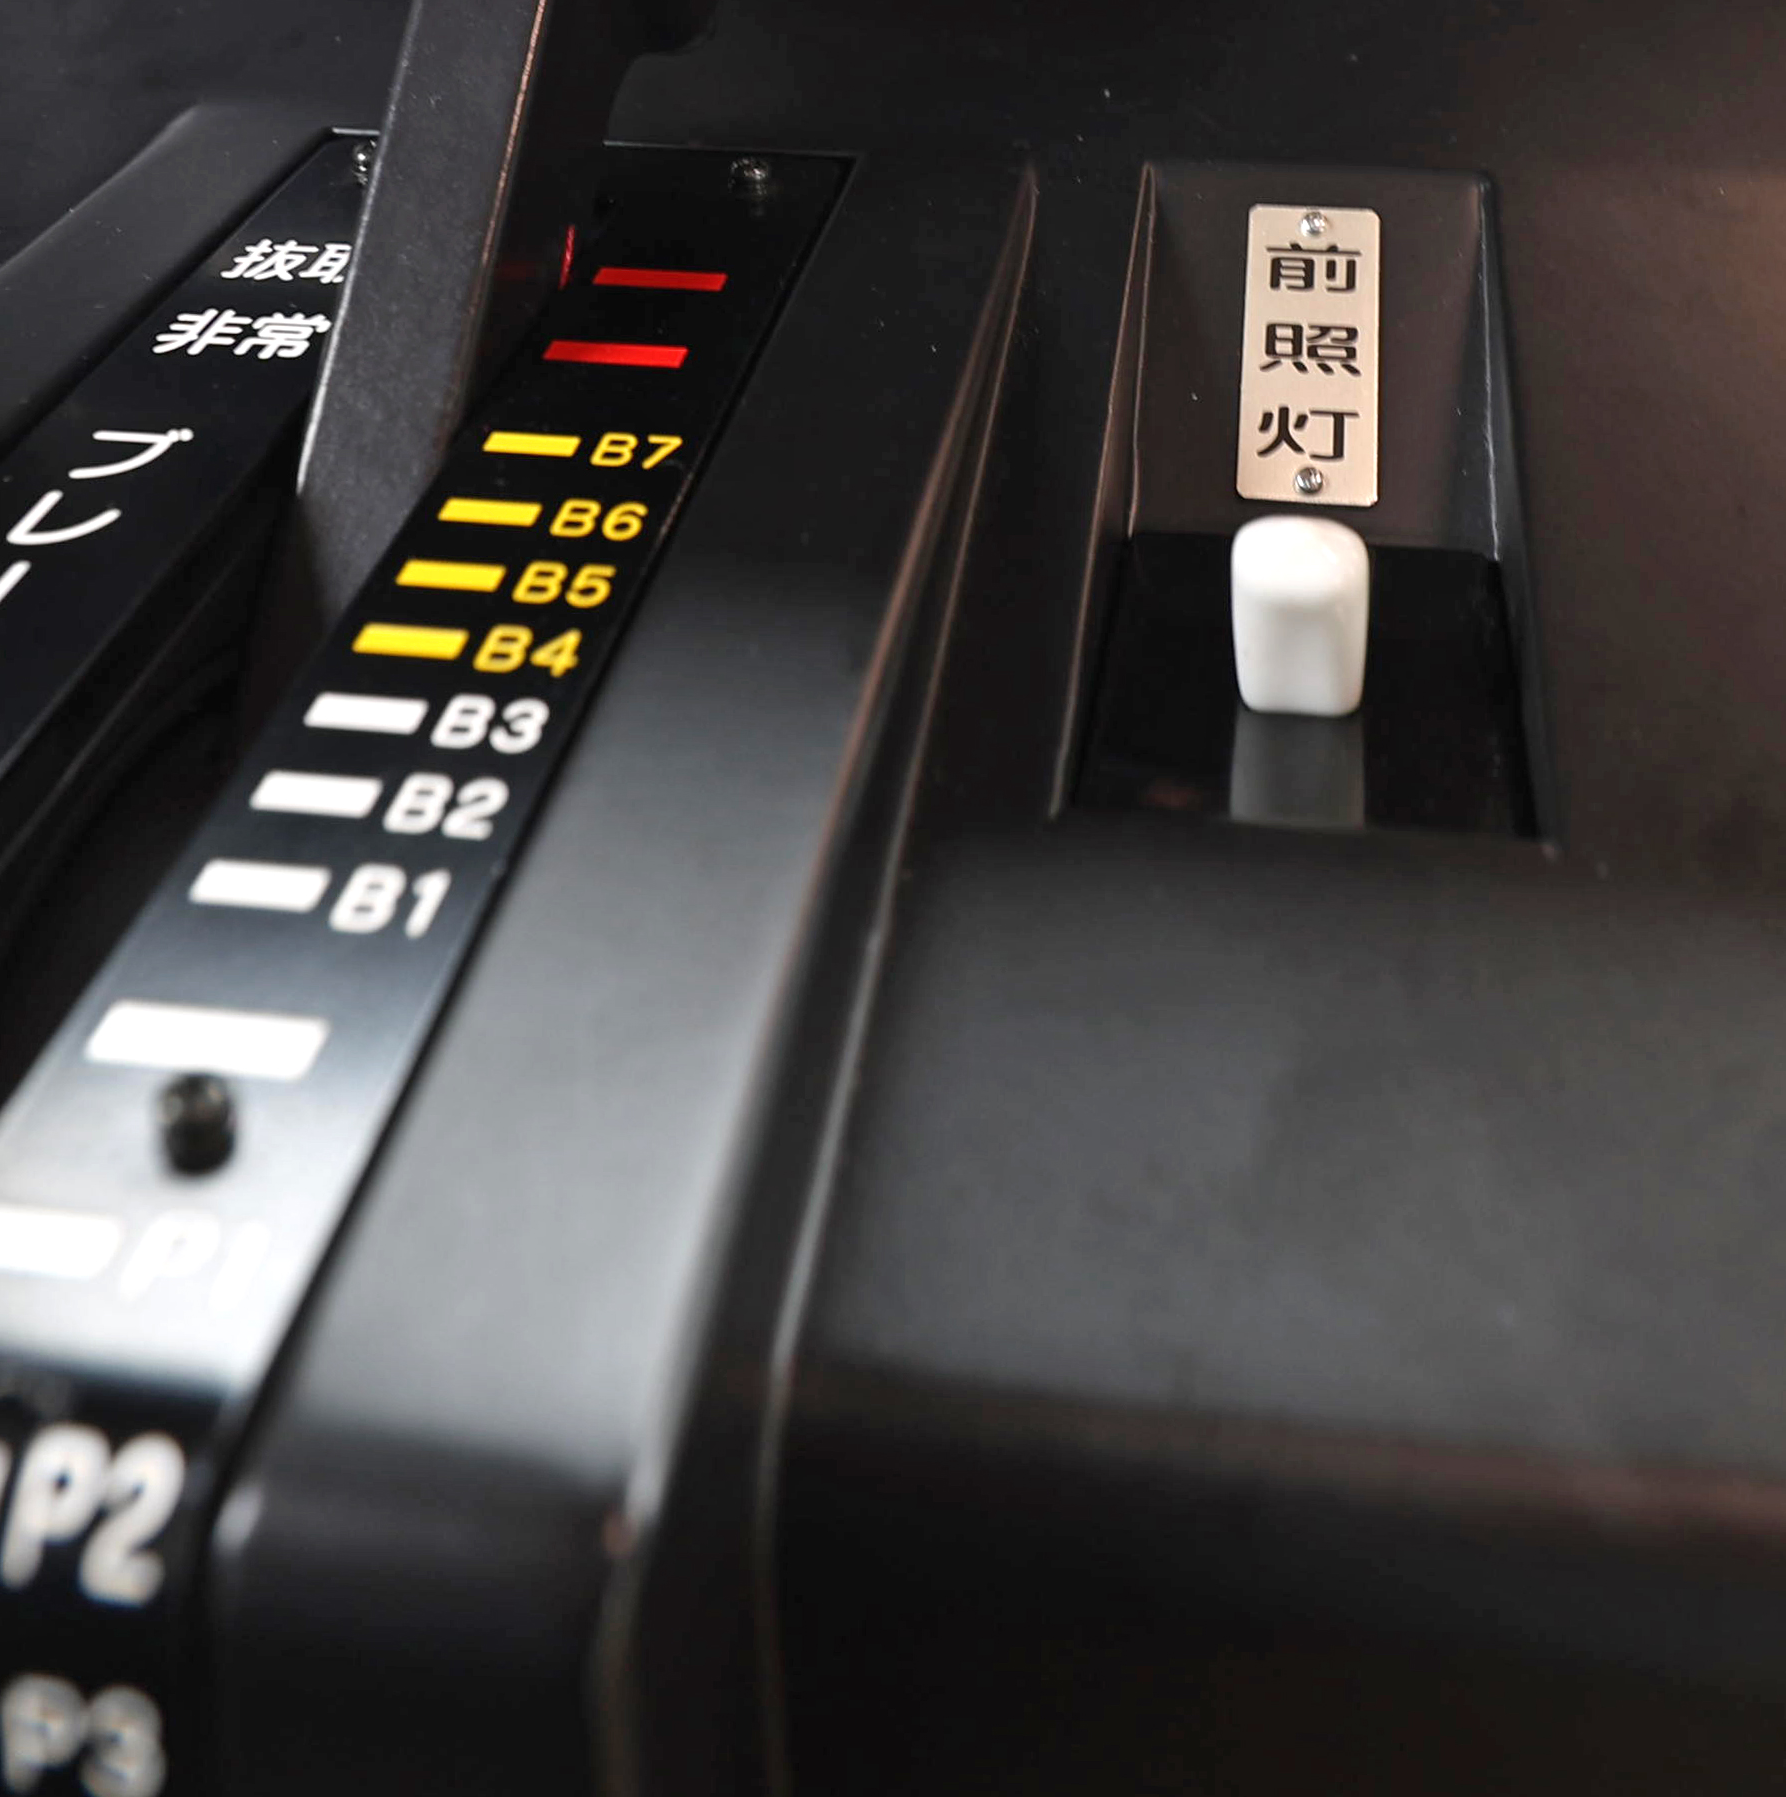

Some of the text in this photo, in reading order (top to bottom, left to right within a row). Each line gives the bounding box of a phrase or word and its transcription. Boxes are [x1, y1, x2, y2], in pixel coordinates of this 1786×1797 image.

[153, 308, 332, 360] 非常
[1256, 242, 1362, 462] 前照灯
[591, 432, 683, 469] B7
[550, 499, 649, 541] B6
[513, 561, 617, 609] B5
[473, 624, 583, 679] B4
[430, 694, 550, 754] B3
[383, 772, 510, 841] B2
[328, 862, 452, 939] B1
[119, 1210, 273, 1312] P1
